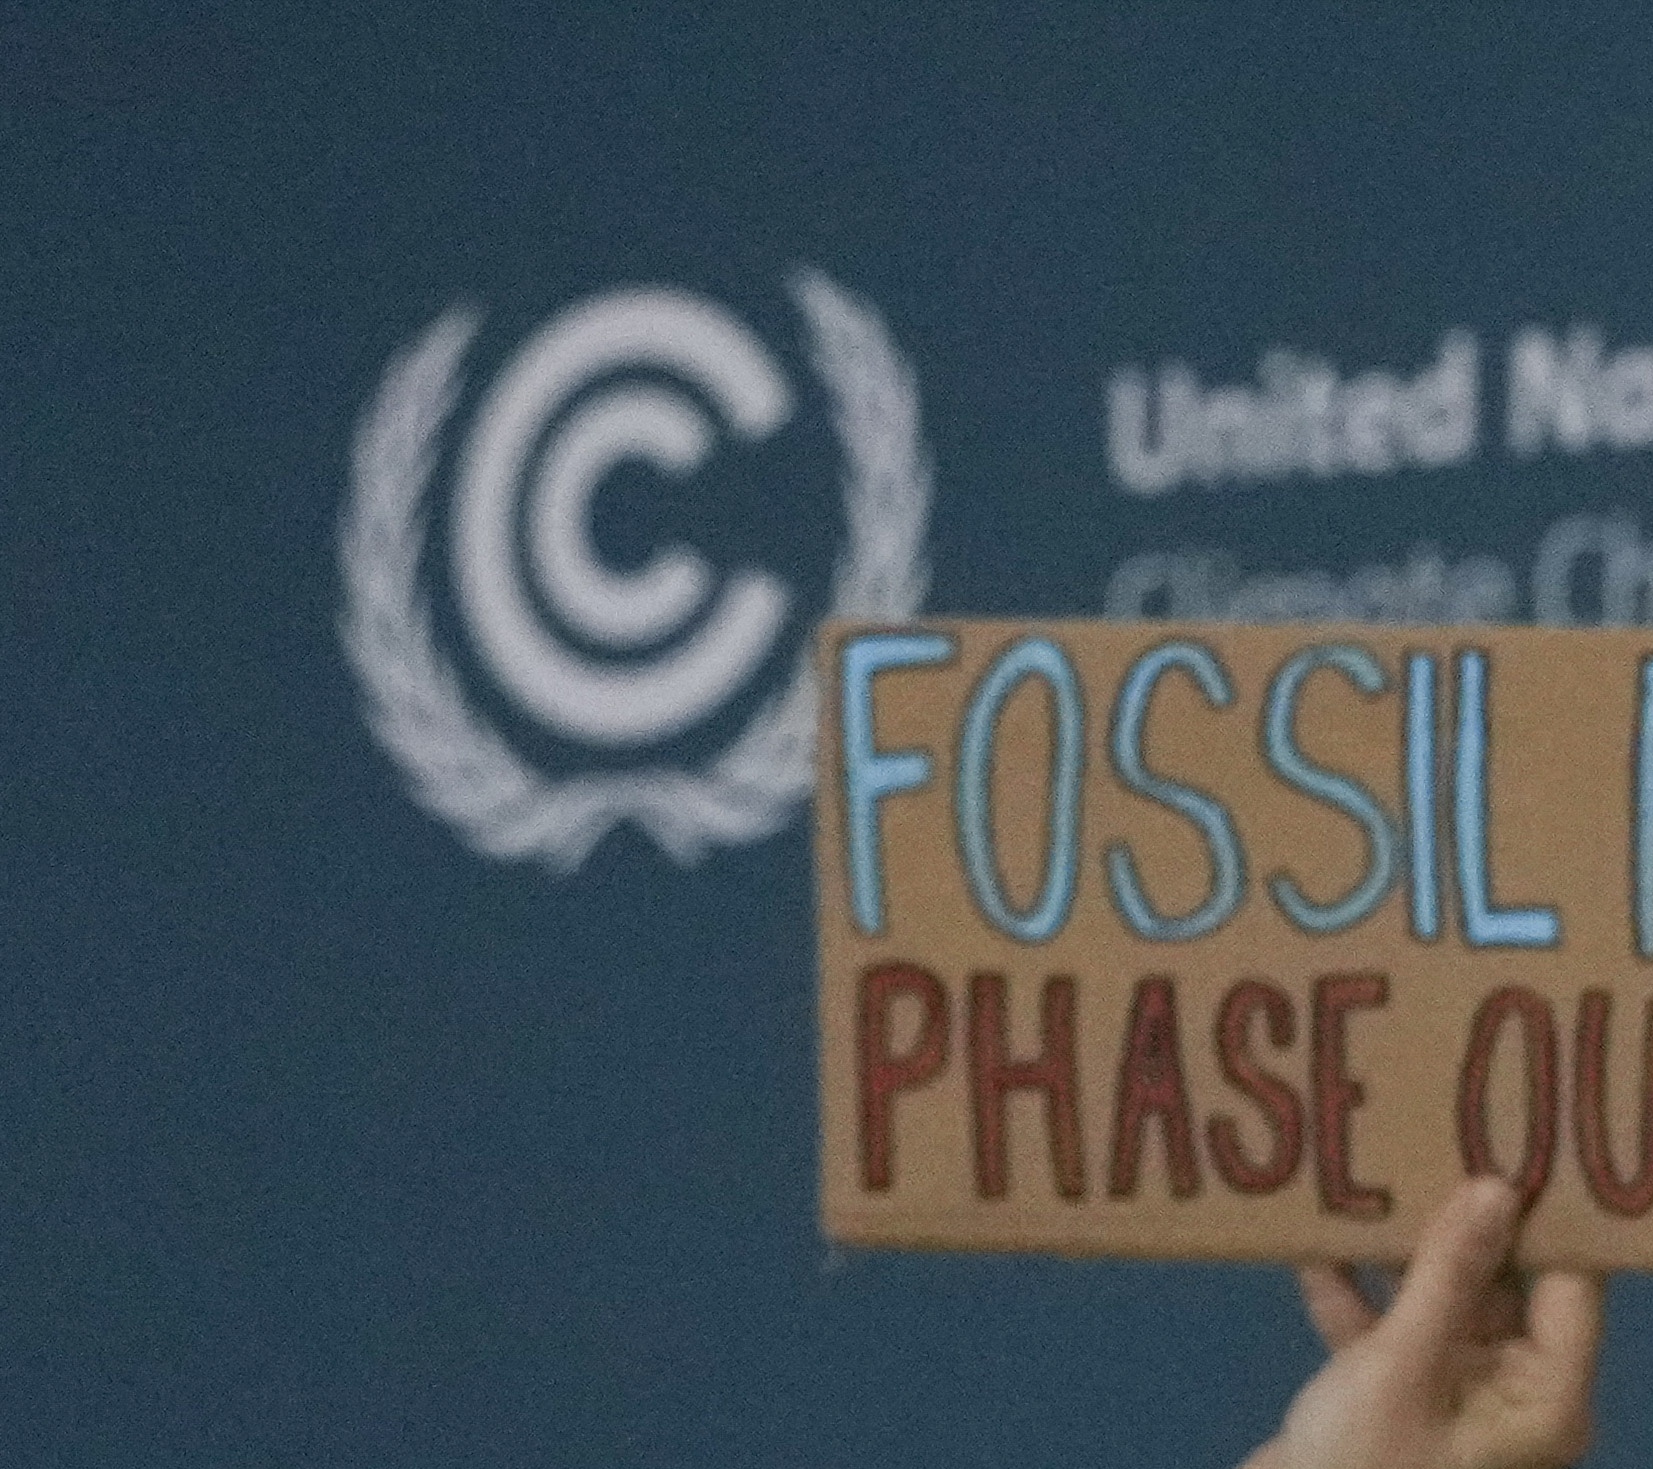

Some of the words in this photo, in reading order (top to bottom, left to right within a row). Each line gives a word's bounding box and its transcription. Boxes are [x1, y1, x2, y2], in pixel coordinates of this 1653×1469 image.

[1105, 328, 1478, 496] United
[838, 633, 1563, 949] FOSSIL
[855, 960, 1393, 1214] PHASE
